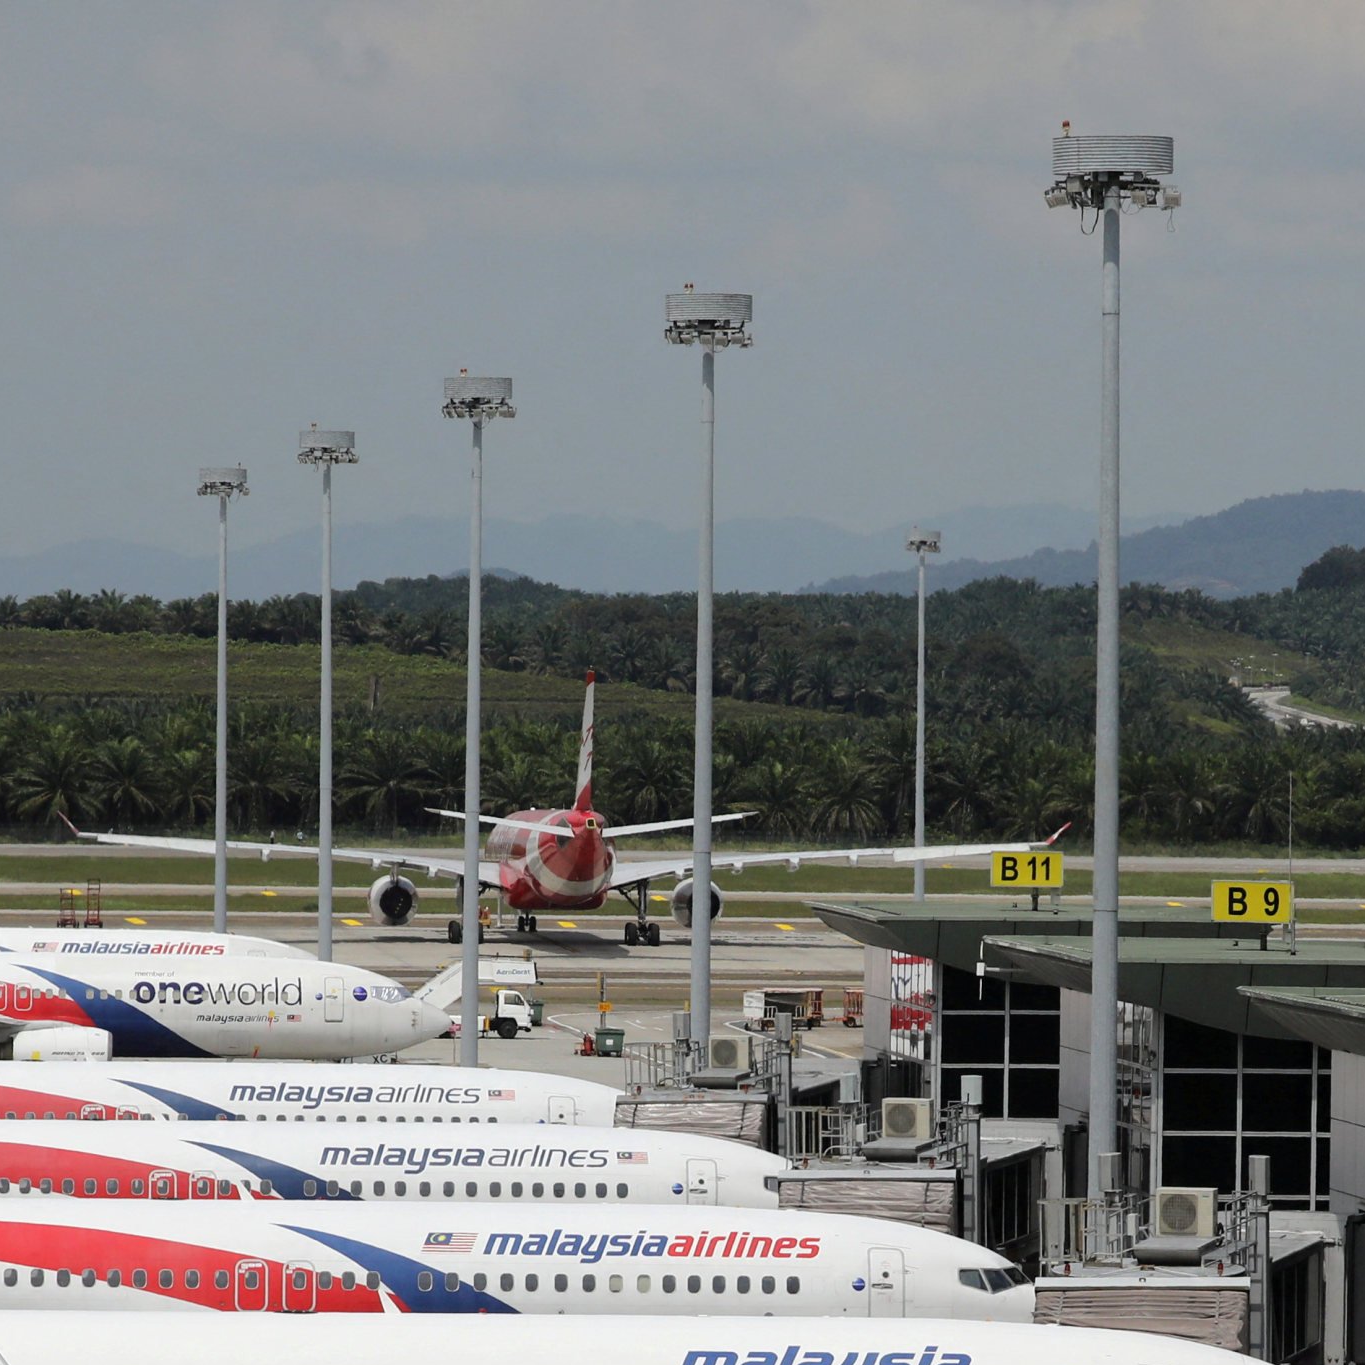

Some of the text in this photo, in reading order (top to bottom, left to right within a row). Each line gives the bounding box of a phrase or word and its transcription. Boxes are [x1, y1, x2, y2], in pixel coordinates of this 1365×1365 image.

[1001, 856, 1052, 881] B 11
[1228, 886, 1280, 917] B 9
[132, 976, 303, 1006] oneworld
[195, 1013, 244, 1025] malaysia
[229, 1081, 482, 1110] malaysia airlines
[319, 1143, 610, 1175] malaysia airlines
[482, 1228, 821, 1265] malaysia airlines
